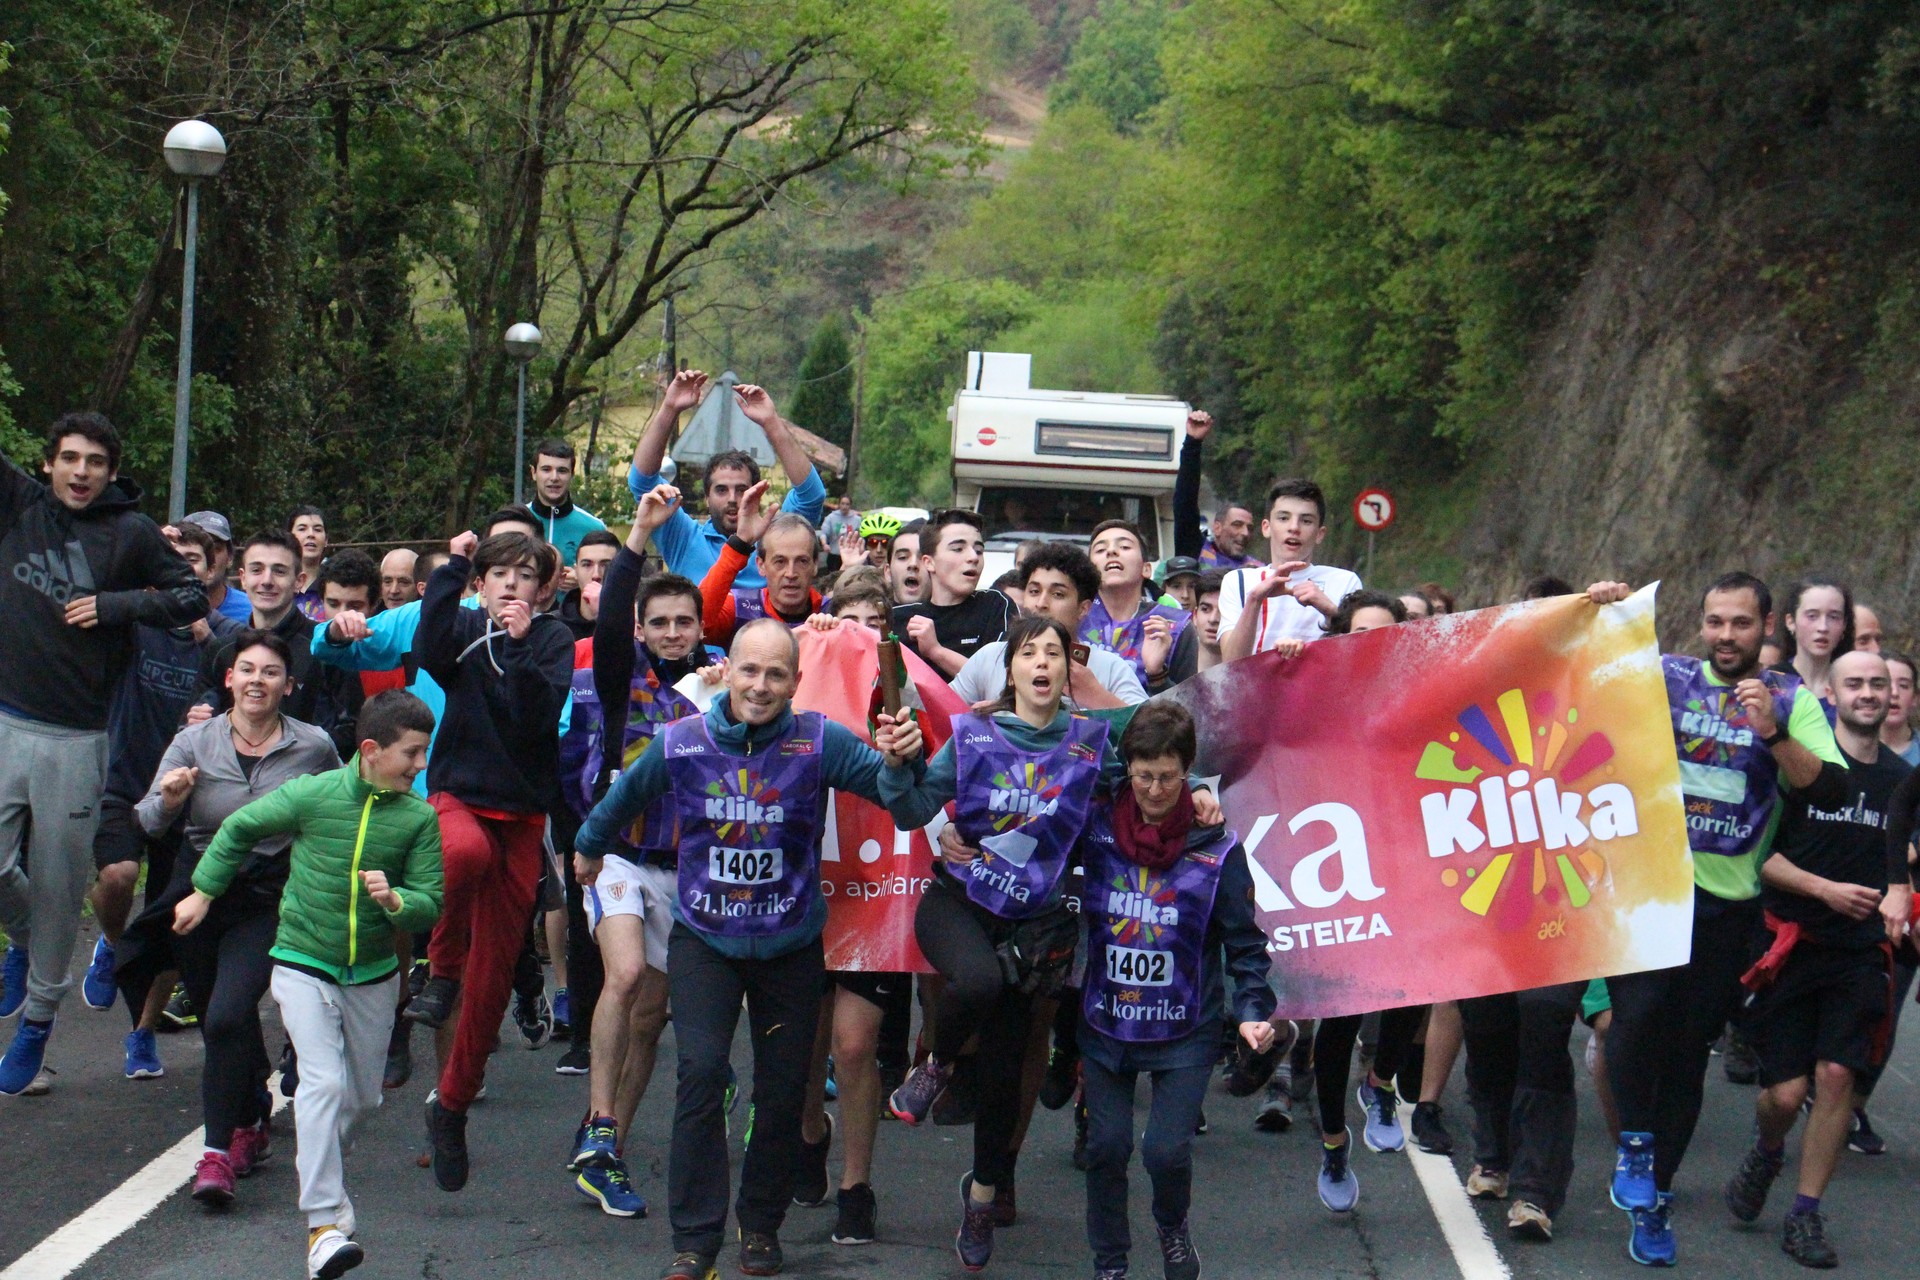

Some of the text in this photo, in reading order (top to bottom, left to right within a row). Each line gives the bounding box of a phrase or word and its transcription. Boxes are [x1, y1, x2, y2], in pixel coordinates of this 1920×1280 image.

[1680, 711, 1754, 747] Klika
[704, 795, 784, 825] Klika
[1419, 769, 1639, 858] Klika
[1689, 801, 1713, 816] aek
[715, 849, 774, 882] 1402
[690, 889, 797, 917] 21. korrika
[728, 888, 754, 901] aek
[1107, 891, 1179, 926] Klika
[1537, 913, 1566, 941] aek
[1109, 949, 1166, 982] 1402
[1112, 995, 1186, 1021] korrika
[1118, 987, 1143, 1003] aek
